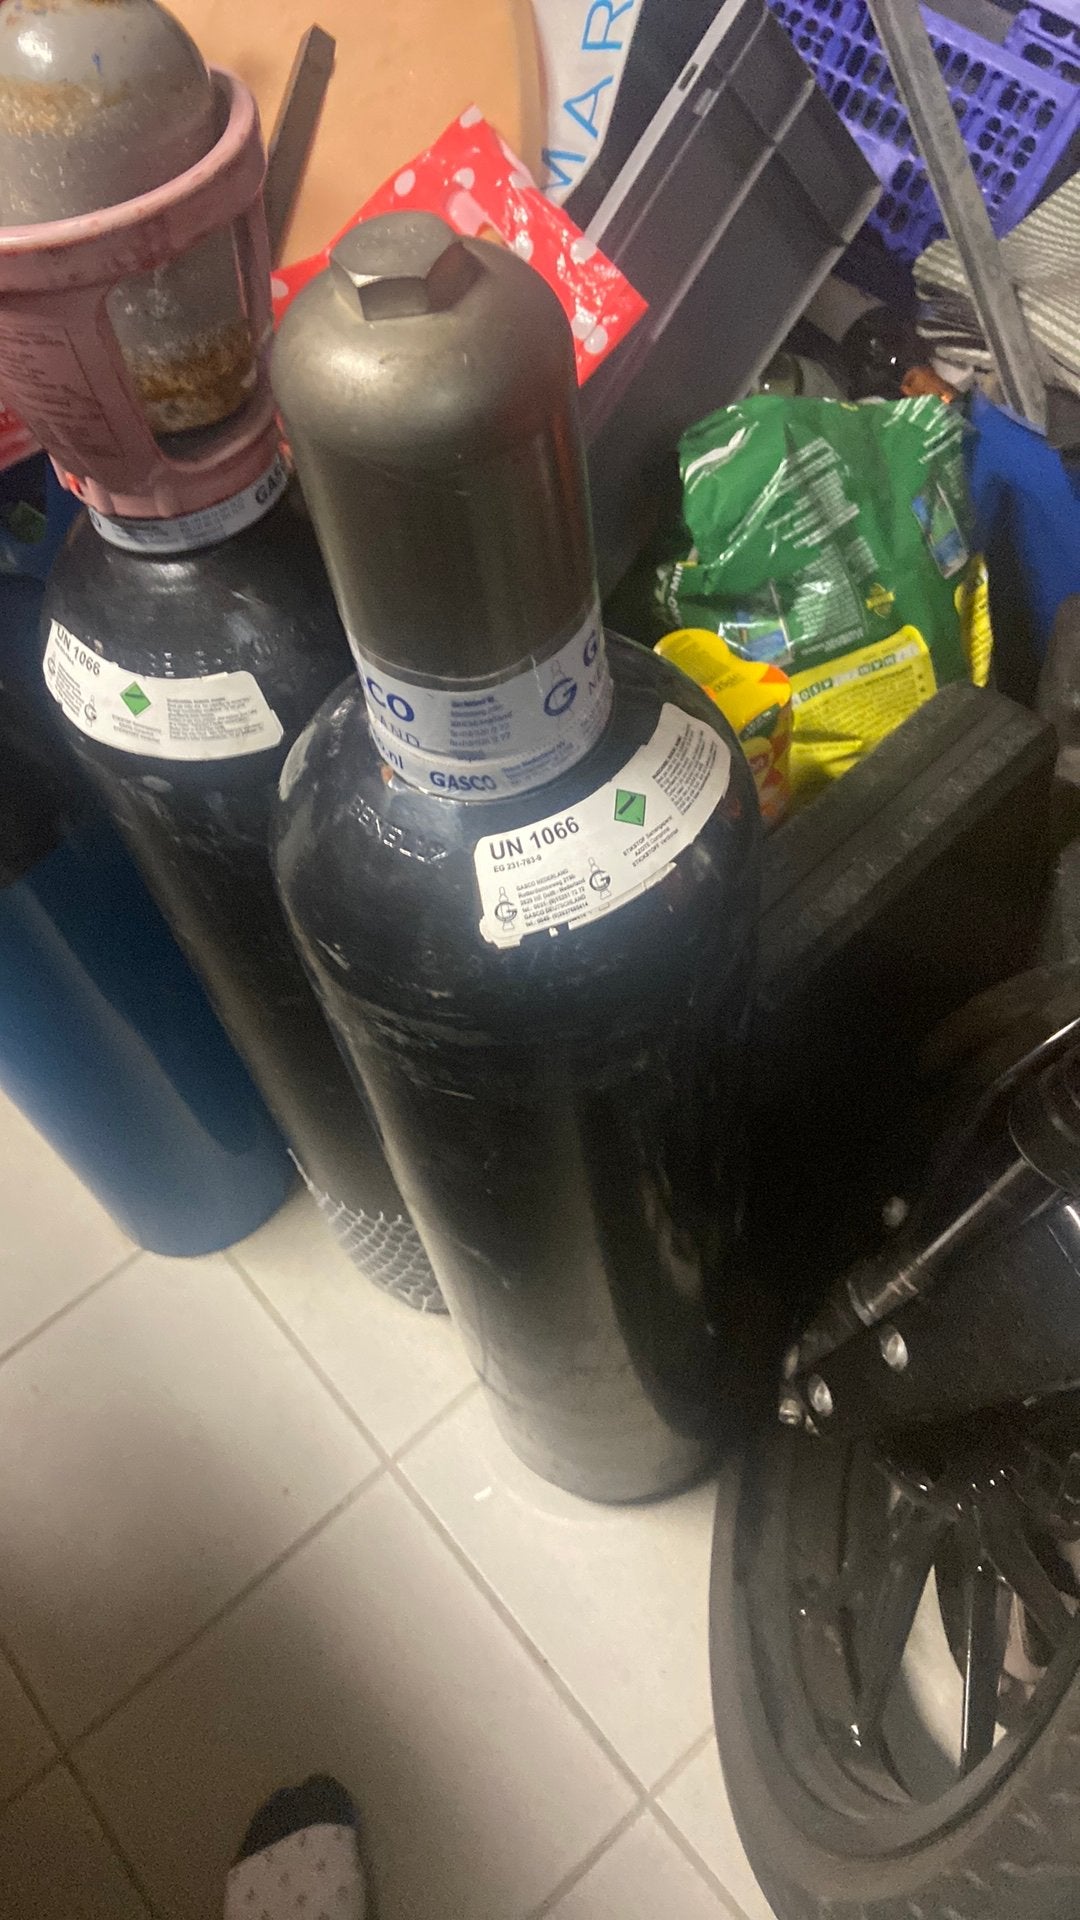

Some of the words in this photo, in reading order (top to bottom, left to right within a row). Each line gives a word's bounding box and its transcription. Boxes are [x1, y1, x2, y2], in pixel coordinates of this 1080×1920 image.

[56, 626, 71, 648] UN
[73, 645, 100, 676] 1066
[544, 677, 577, 717] G
[429, 771, 497, 791] GASCO
[490, 836, 523, 860] UN
[529, 816, 580, 849] 1066
[494, 864, 505, 873] EG
[516, 880, 536, 891] GASCO
[536, 868, 569, 885] NEDERLAND
[524, 909, 545, 920] GASCO
